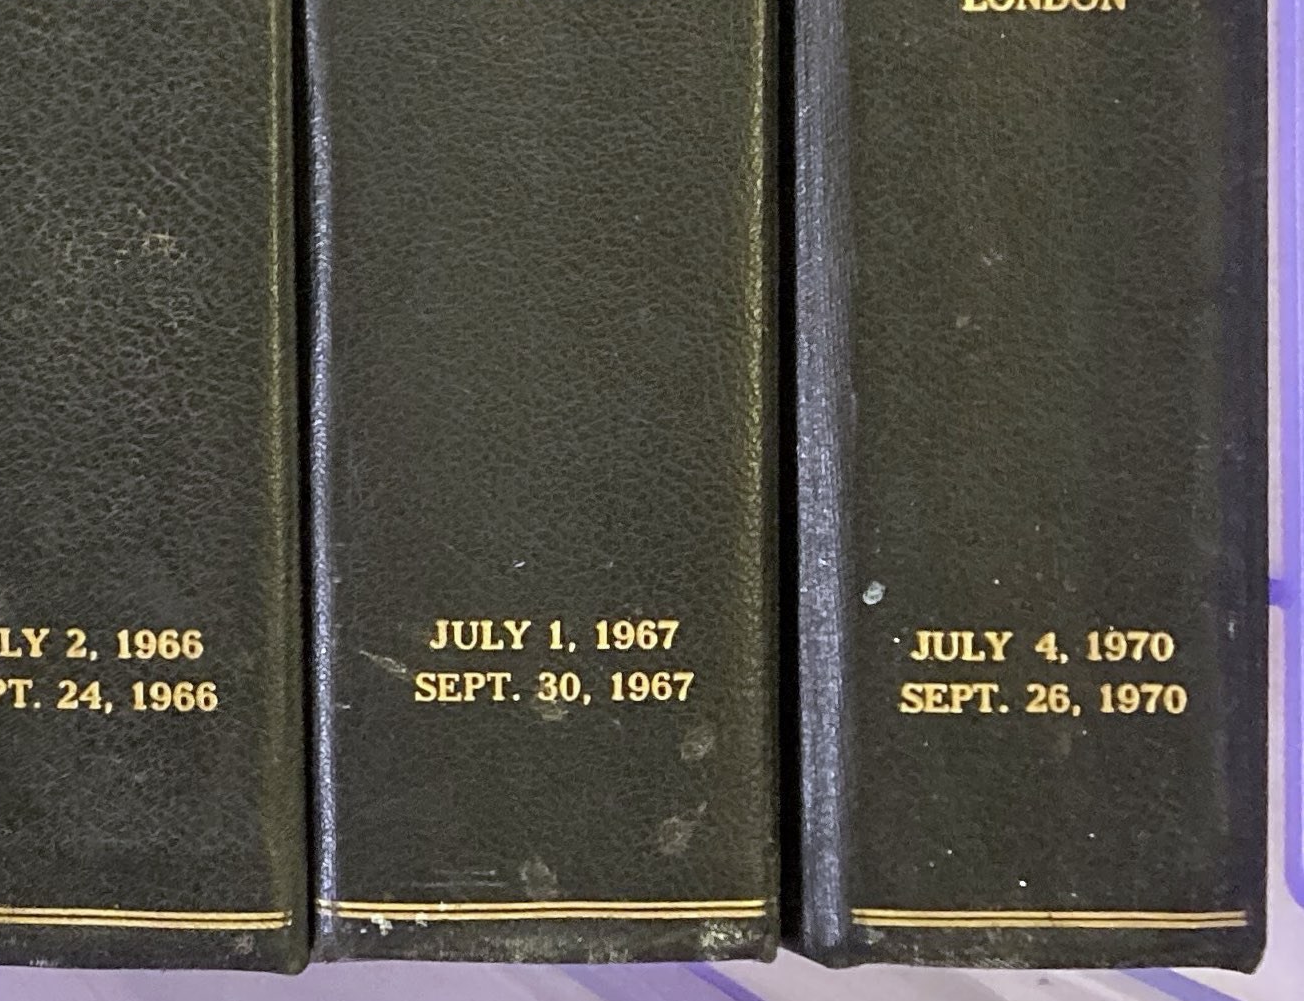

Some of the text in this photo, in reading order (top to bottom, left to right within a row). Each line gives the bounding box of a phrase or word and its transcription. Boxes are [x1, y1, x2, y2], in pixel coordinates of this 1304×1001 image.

[66, 628, 95, 660] 2,
[117, 629, 204, 660] 1966
[429, 619, 679, 652] JULY 1, 1967
[909, 627, 1175, 664] JULY 4, 1970
[57, 680, 113, 713] 24,
[132, 681, 218, 712] 1966
[413, 672, 694, 705] SEPT. 30, 1967
[897, 683, 1187, 716] SEPT. 26, 1970
